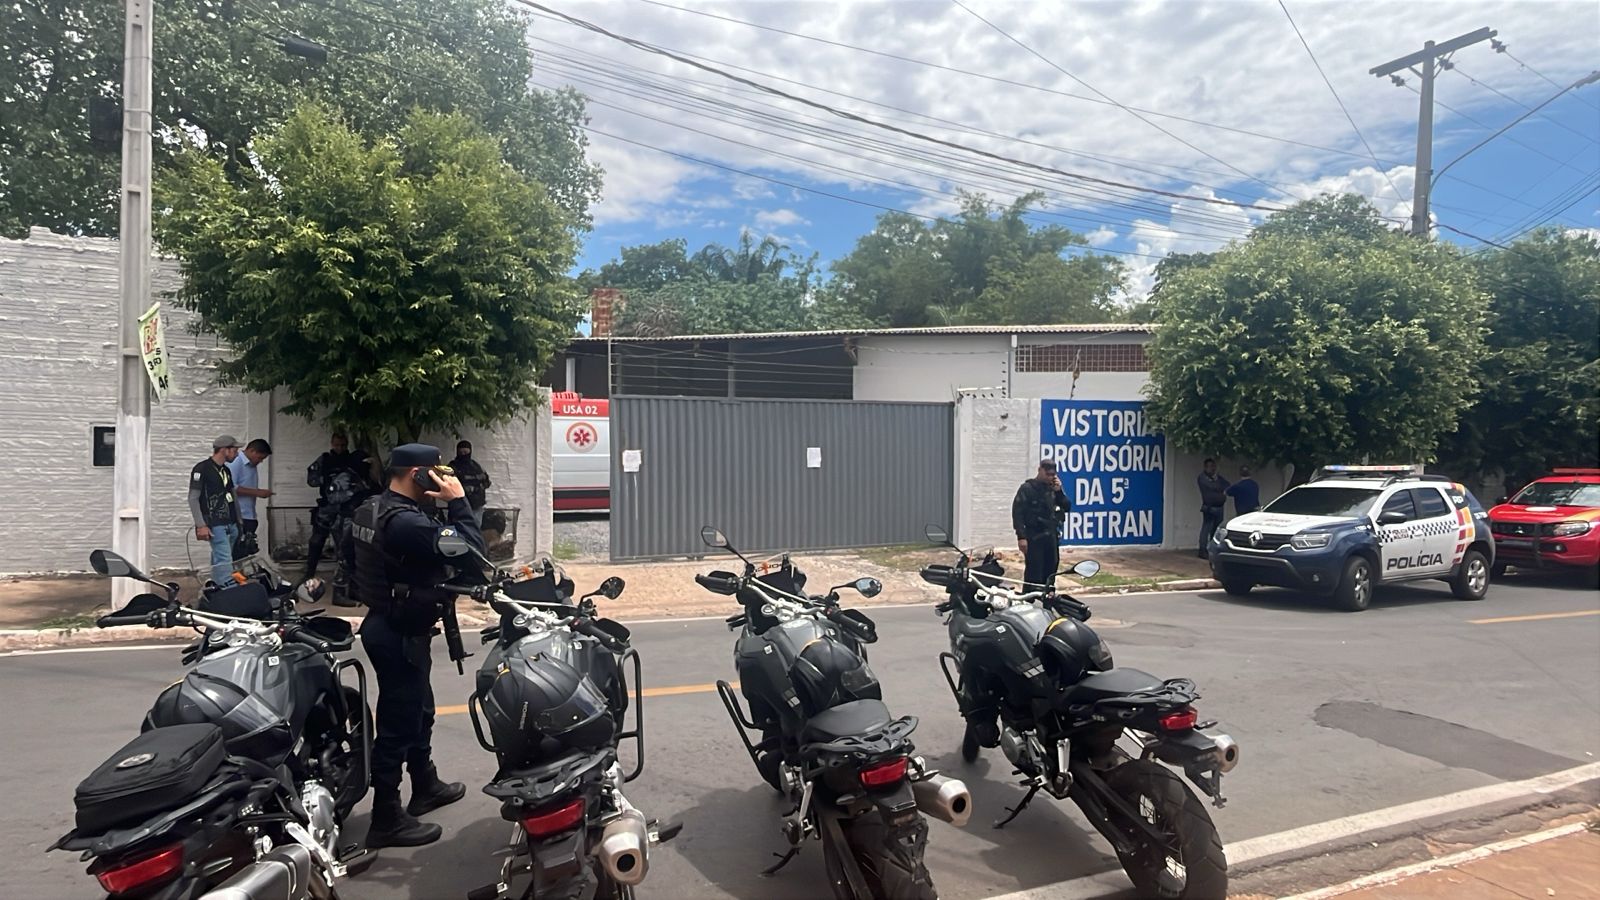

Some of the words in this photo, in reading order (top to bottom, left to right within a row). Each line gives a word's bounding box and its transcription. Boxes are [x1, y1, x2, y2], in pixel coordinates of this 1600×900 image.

[562, 404, 583, 414] USA
[584, 405, 598, 415] 02
[1040, 439, 1163, 473] PROVISÓRIA
[1075, 477, 1105, 506] DA
[1058, 510, 1153, 540] IRETRAN
[1386, 550, 1443, 571] POLÍCIA
